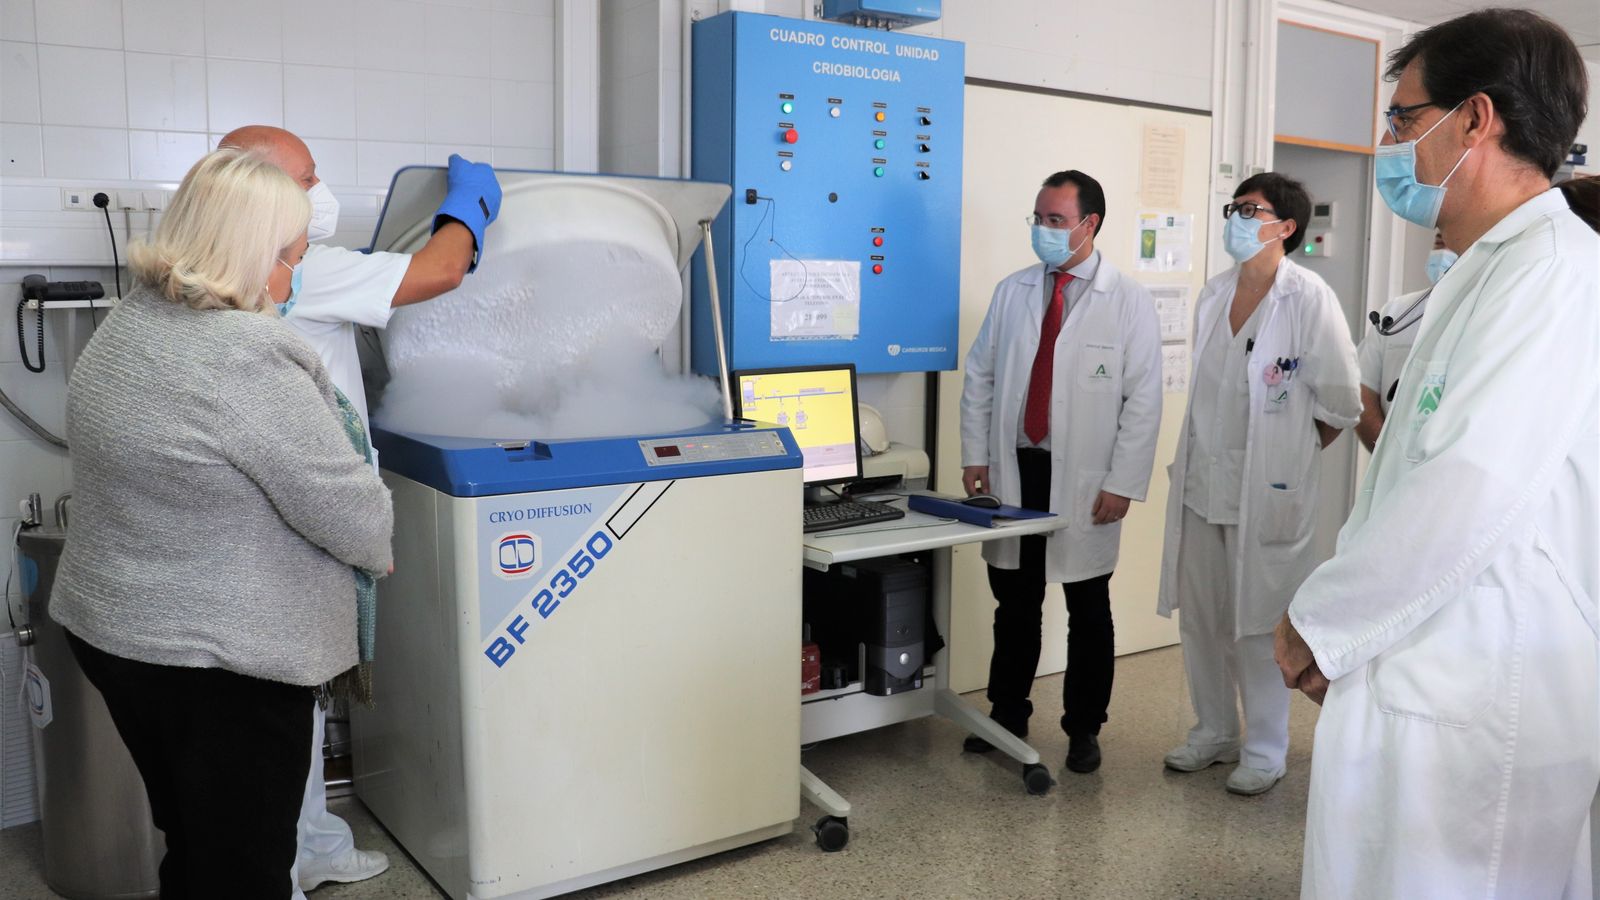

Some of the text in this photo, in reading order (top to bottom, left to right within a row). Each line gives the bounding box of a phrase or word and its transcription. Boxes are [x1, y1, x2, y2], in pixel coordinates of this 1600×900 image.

[770, 28, 939, 61] CUADRO CONTROL UNIDAD
[812, 61, 901, 82] CRIOBIOLOGIA
[489, 502, 592, 524] CRYO DIFFUSION
[484, 530, 613, 668] BF 2350
